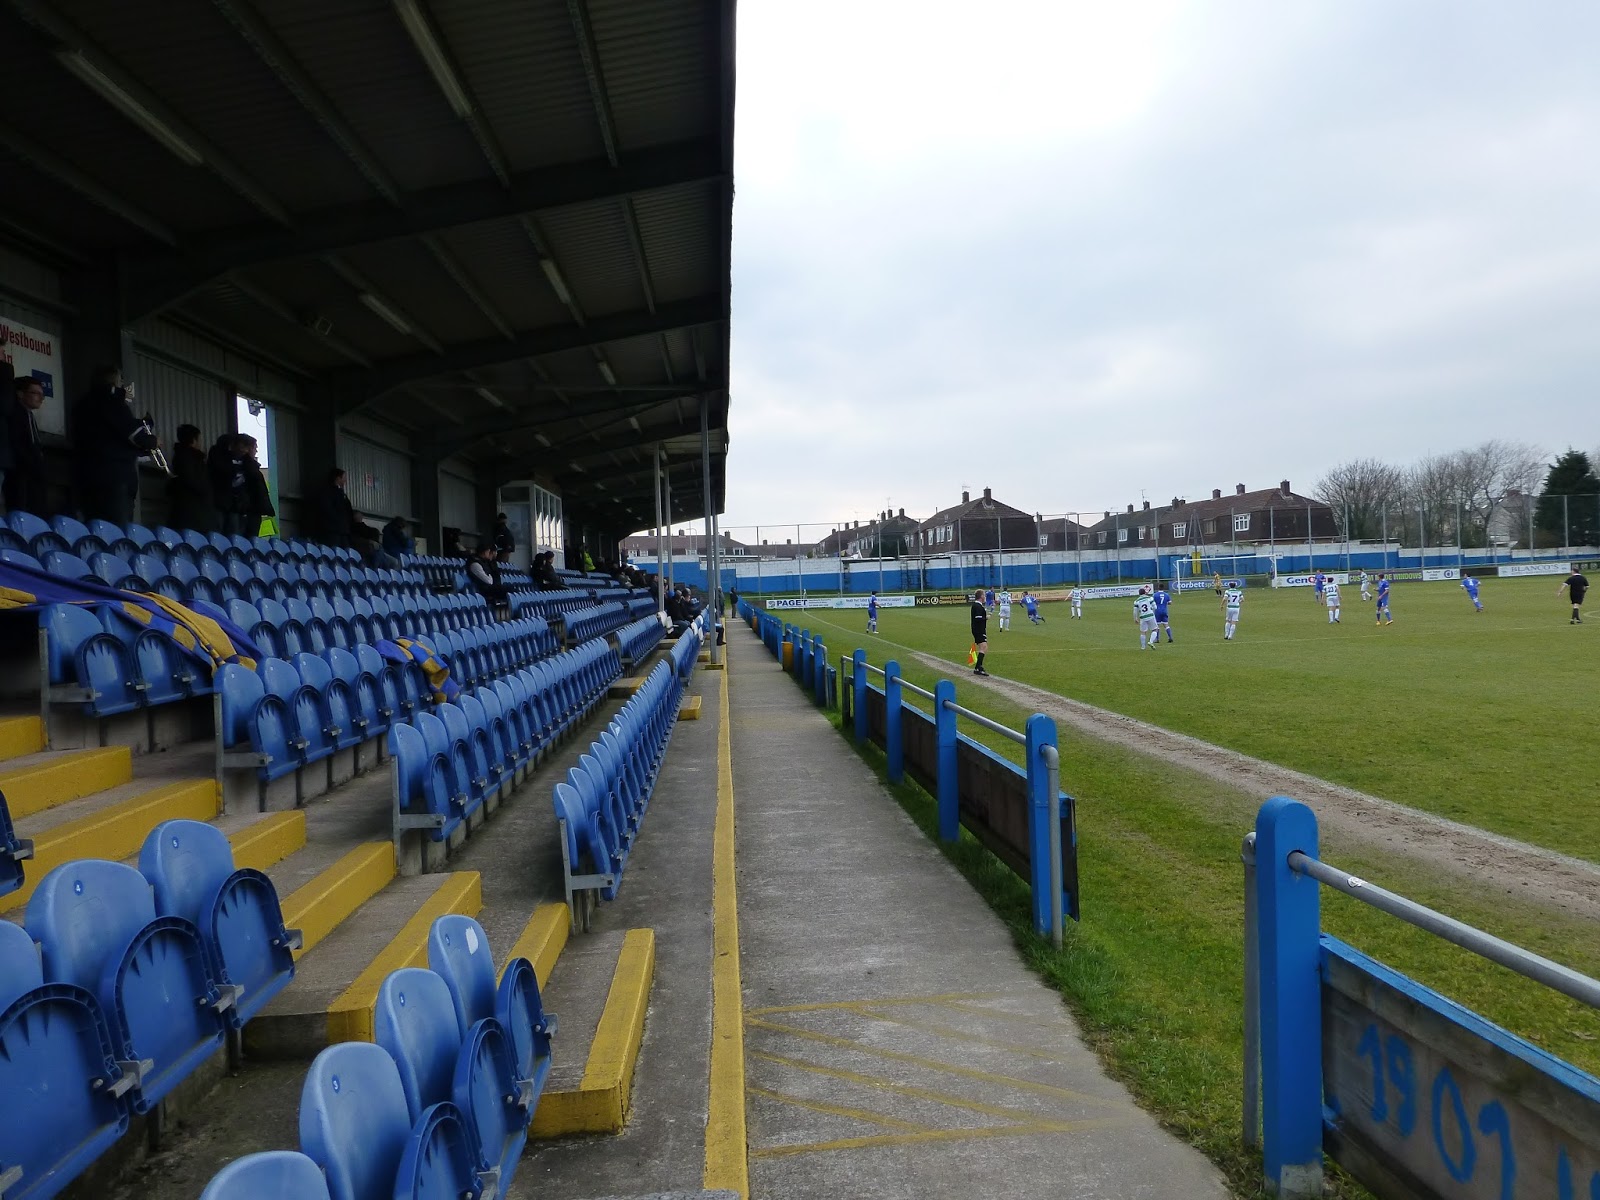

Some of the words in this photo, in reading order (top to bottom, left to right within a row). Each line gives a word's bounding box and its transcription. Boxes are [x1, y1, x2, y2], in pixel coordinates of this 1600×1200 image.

[0, 324, 51, 356] Westbound
[1511, 564, 1559, 572] BLANCO'S
[1375, 573, 1392, 581] MDE
[1393, 572, 1422, 580] WINDOWS
[1141, 604, 1148, 613] 3
